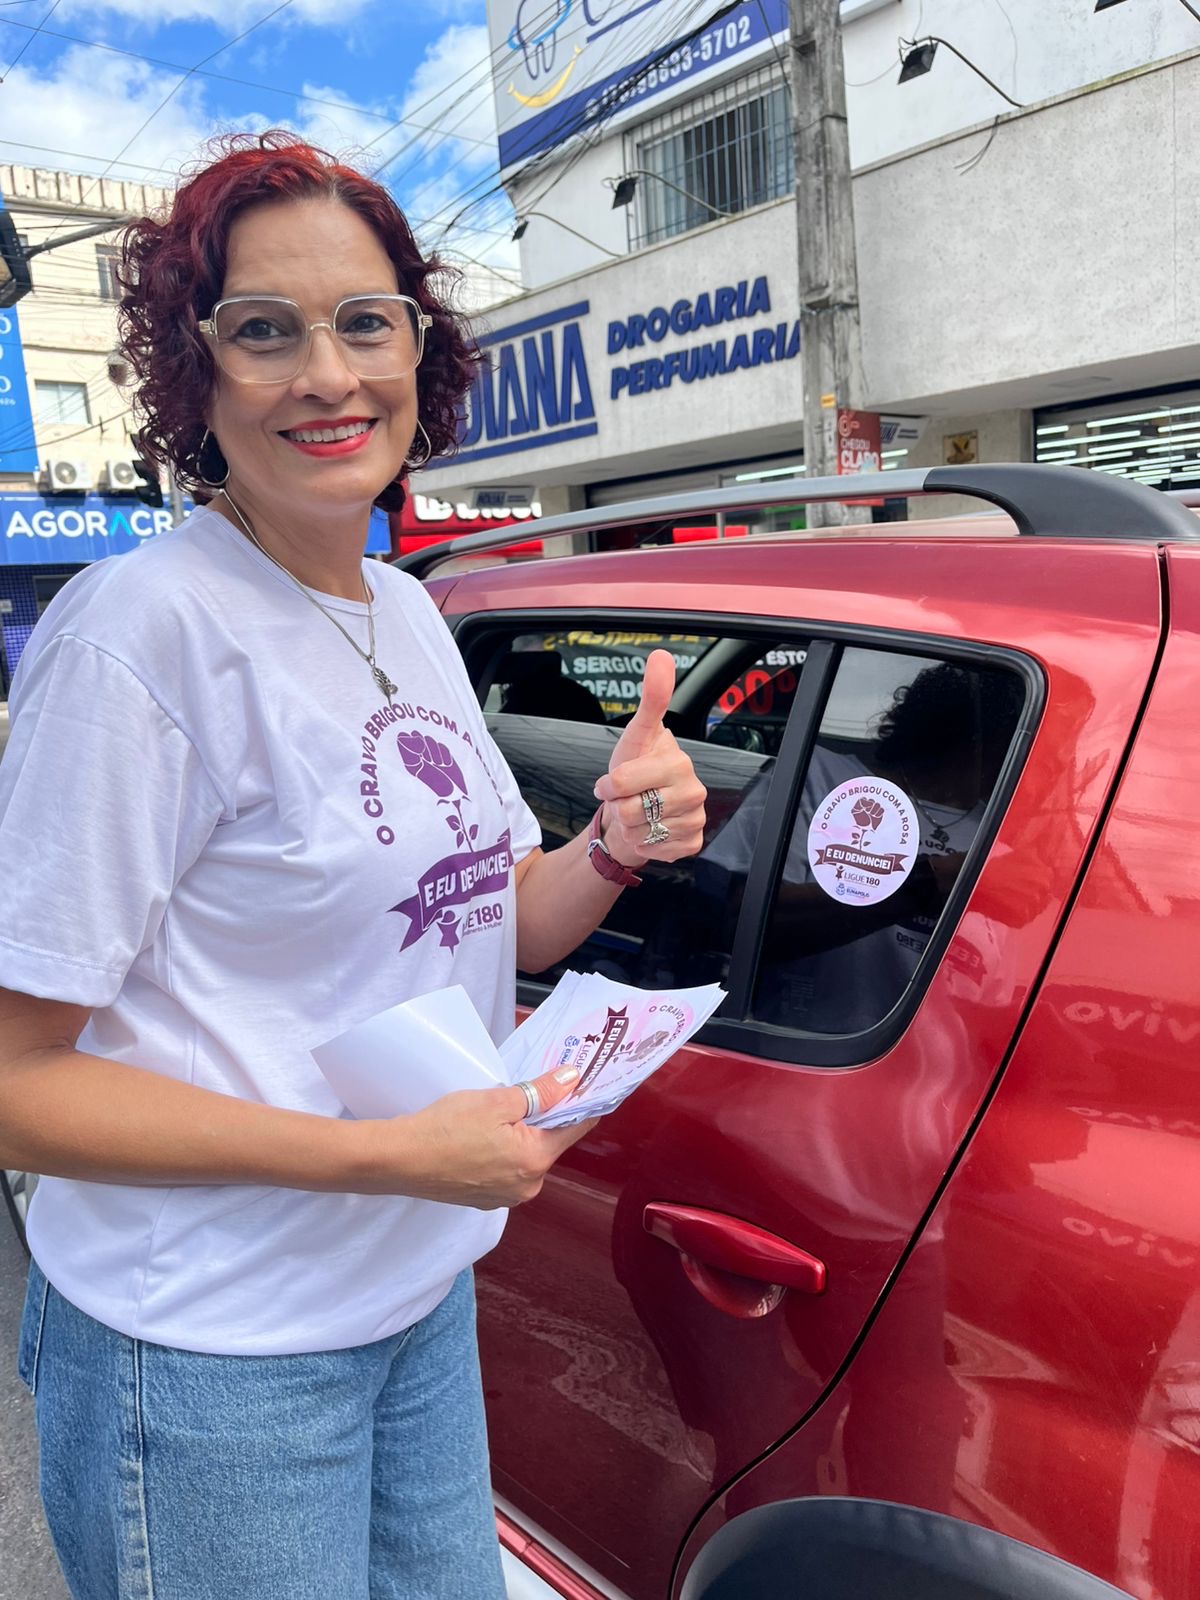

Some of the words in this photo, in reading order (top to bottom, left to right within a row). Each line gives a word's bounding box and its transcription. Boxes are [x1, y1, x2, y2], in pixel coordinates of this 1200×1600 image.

[607, 276, 771, 355] DROGARIA
[573, 656, 647, 674] SERGIO
[364, 702, 416, 741] BRIGOU
[416, 705, 459, 735] COM
[462, 731, 473, 748] A
[360, 736, 384, 818] CRAVO
[848, 785, 882, 796] BRIGOU
[882, 790, 900, 809] COM
[823, 792, 847, 820] CRAVO
[898, 808, 906, 817] A
[376, 825, 395, 846] O
[821, 822, 828, 830] O
[900, 816, 910, 845] ROSA
[826, 848, 833, 858] E
[832, 849, 845, 860] EU
[845, 852, 892, 870] DENUNCIEI
[844, 872, 865, 883] LIGUE
[865, 876, 880, 887] 180
[424, 881, 435, 908] E
[436, 872, 457, 902] EU
[648, 1005, 657, 1013] O
[614, 1019, 625, 1027] E
[607, 1027, 621, 1042] EU
